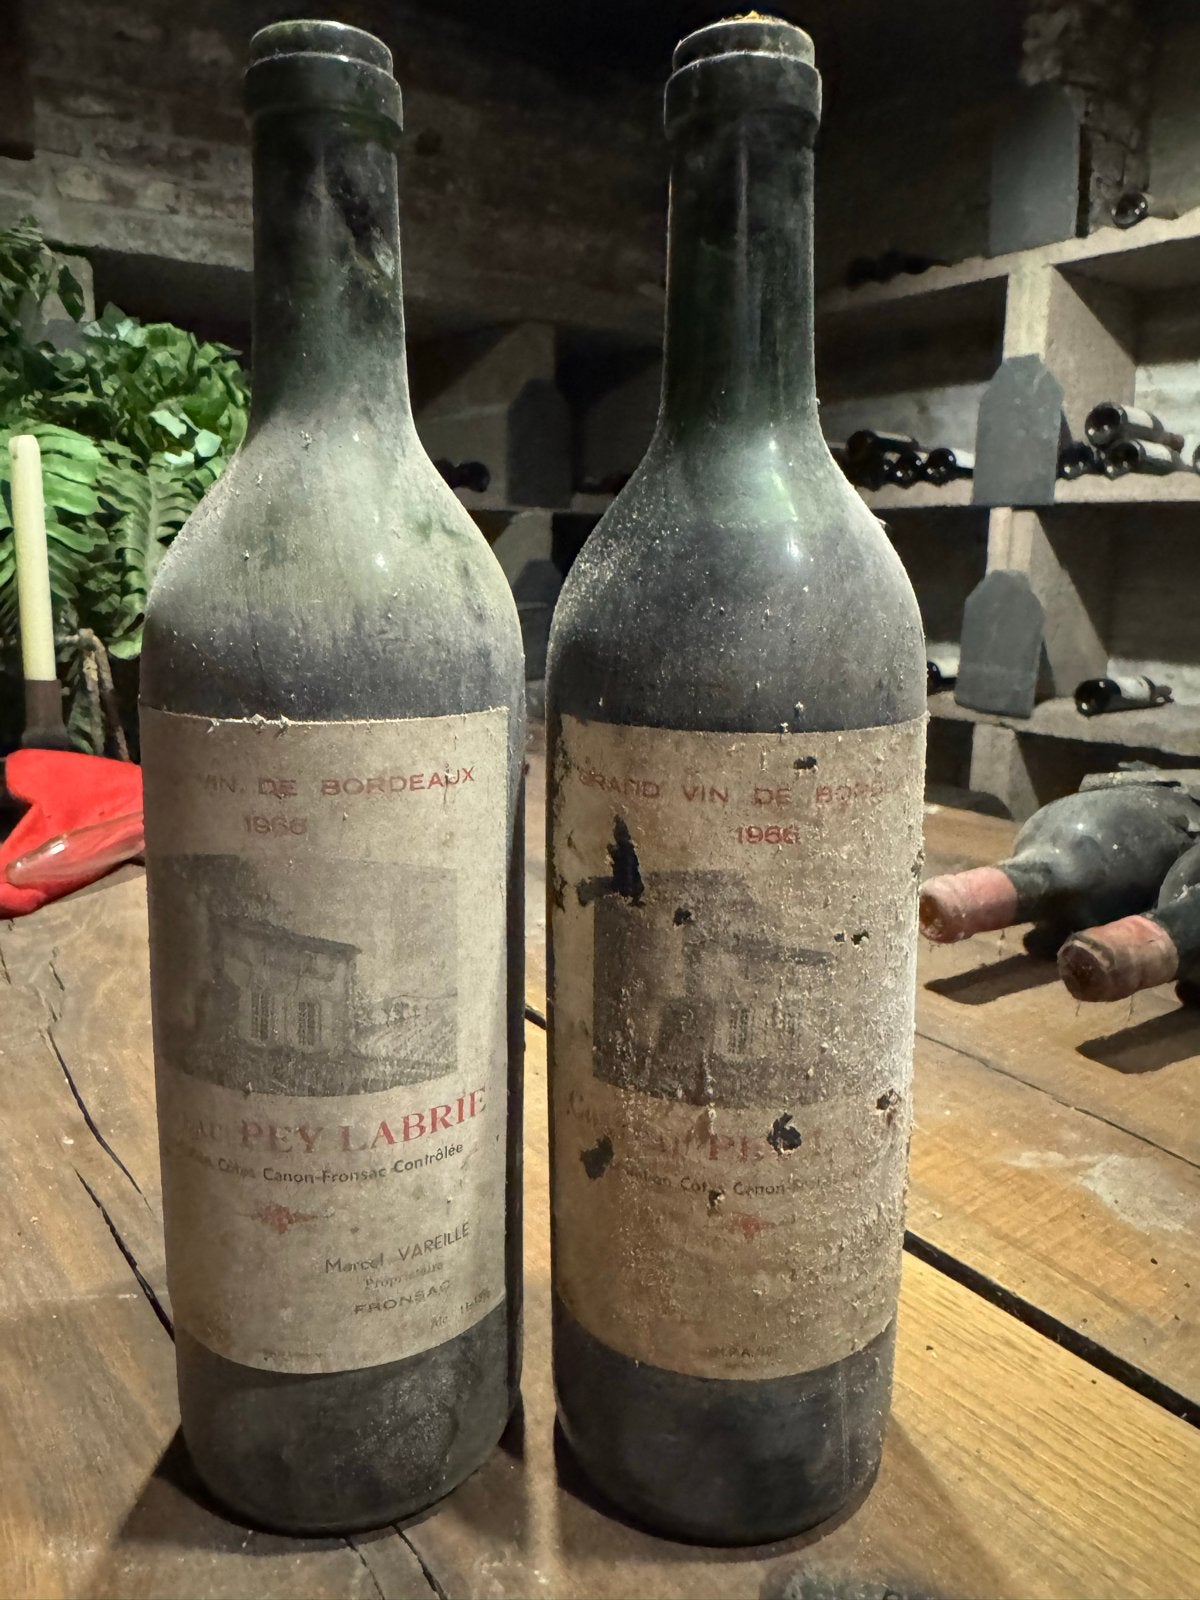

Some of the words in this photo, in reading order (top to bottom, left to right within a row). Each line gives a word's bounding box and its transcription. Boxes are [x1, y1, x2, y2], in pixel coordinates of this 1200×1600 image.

[257, 777, 298, 797] DE
[320, 765, 476, 797] BORDEAUX
[682, 785, 730, 803] VIN
[753, 787, 793, 806] DE
[736, 824, 800, 845] 1966
[339, 1086, 487, 1151] LABRIE
[393, 1141, 464, 1174] Contrôlée
[324, 1252, 384, 1275] Marcel
[397, 1220, 471, 1263] VAREILLE
[353, 1278, 452, 1317] FRONSAC
